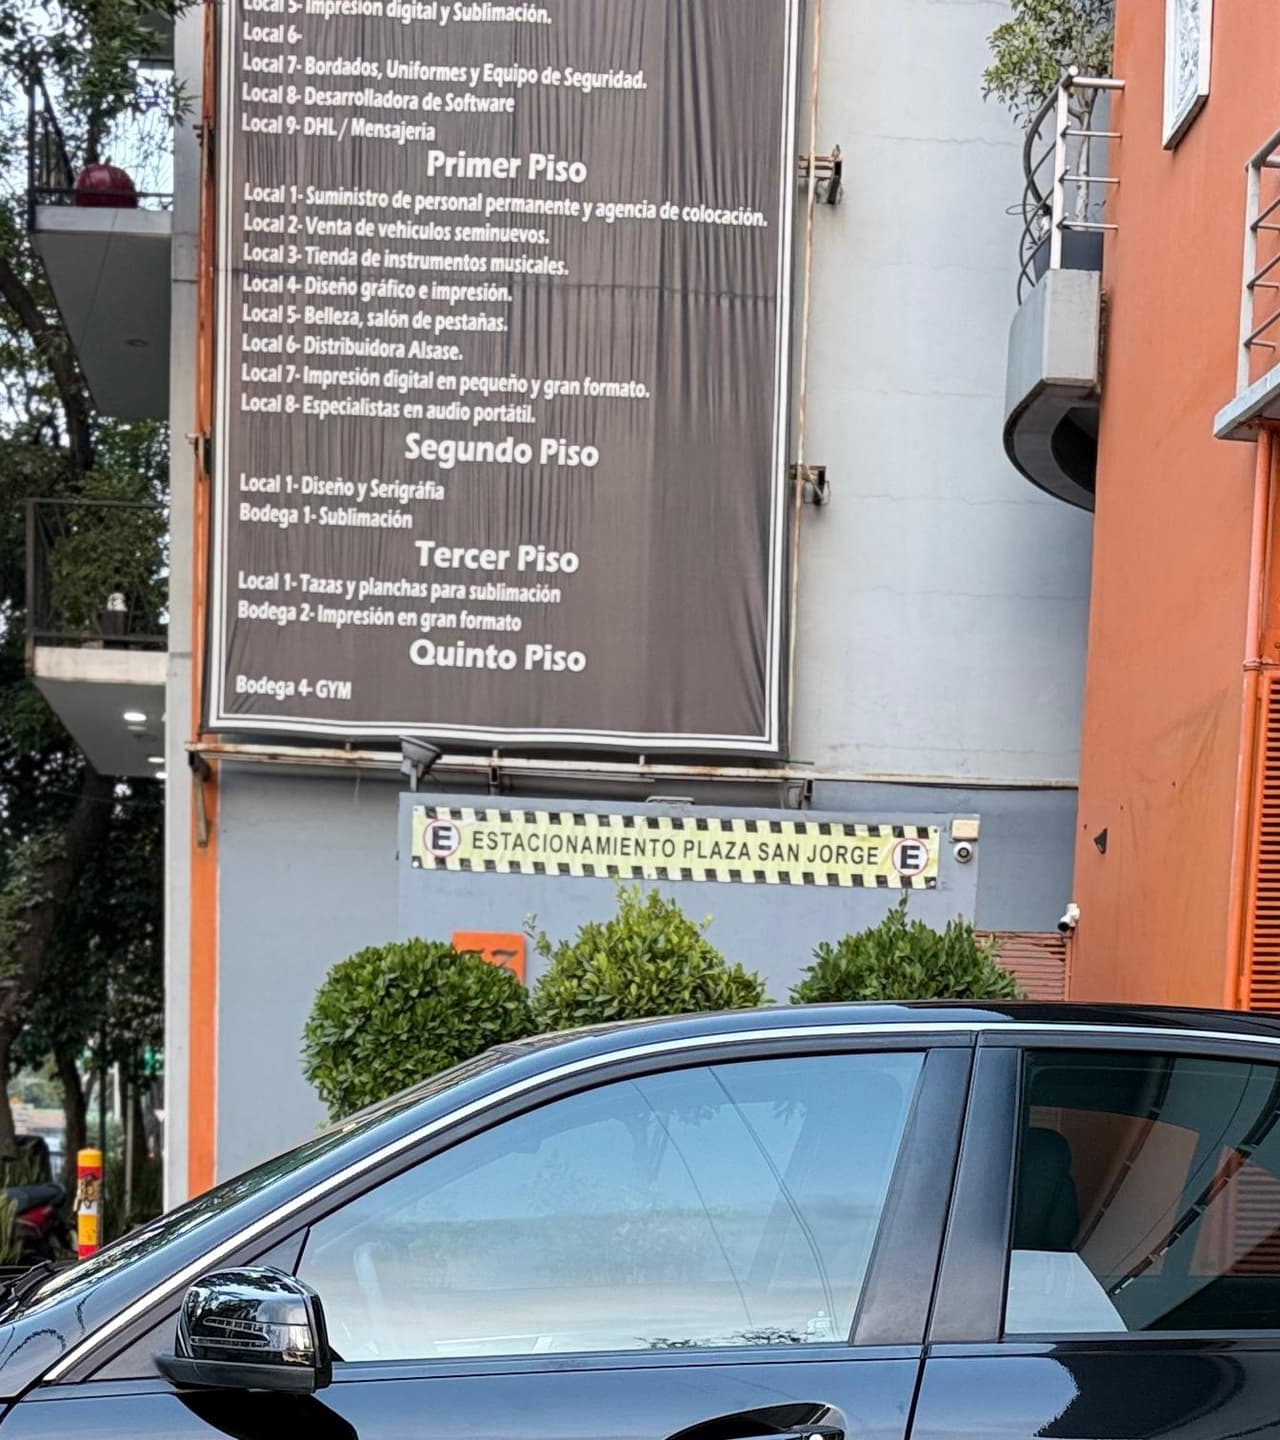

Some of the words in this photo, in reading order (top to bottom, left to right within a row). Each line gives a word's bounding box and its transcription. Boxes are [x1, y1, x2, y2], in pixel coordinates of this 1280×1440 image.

[242, 52, 283, 74] Local
[305, 56, 383, 80] Bordados,
[386, 59, 467, 82] Uniformes
[470, 68, 480, 87] y
[483, 63, 538, 88] Equipo
[541, 66, 561, 86] de
[564, 67, 648, 93] Seguridad.
[242, 82, 282, 104] Local
[304, 86, 418, 110] Desarrolladora
[421, 92, 442, 112] de
[445, 92, 515, 112] Software
[426, 150, 521, 179] Primer
[528, 153, 587, 183] Piso
[244, 182, 285, 203] Local
[305, 185, 389, 208] Suministro
[391, 190, 411, 210] de
[414, 192, 483, 215] personal
[484, 194, 580, 217] permanente
[582, 203, 593, 222] y
[595, 200, 656, 223] agencia
[659, 201, 679, 221] de
[682, 203, 768, 227] colocación.
[243, 242, 283, 264] Local
[304, 245, 358, 267] Tienda
[361, 249, 381, 268] de
[384, 249, 487, 273] instrumentos
[489, 254, 568, 276] musicales.
[242, 273, 283, 293] Local
[304, 276, 359, 297] Diseño
[361, 278, 416, 302] gráfico
[419, 287, 429, 298] e
[431, 281, 512, 306] impresión.
[242, 303, 282, 323] Local
[304, 305, 363, 329] Belleza,
[366, 308, 408, 328] salón
[411, 311, 432, 330] de
[434, 313, 508, 335] pestañas.
[242, 332, 282, 353] Local
[303, 335, 405, 359] Distribuidora
[241, 363, 282, 383] Local
[302, 365, 380, 390] Impresión
[383, 369, 434, 394] digital
[436, 374, 457, 390] en
[459, 373, 528, 397] pequeño
[530, 379, 540, 399] y
[543, 379, 580, 400] gran
[583, 376, 650, 399] formato.
[240, 392, 282, 413] Local
[302, 396, 401, 420] Especialistas
[403, 402, 423, 419] en
[426, 401, 471, 421] audio
[473, 403, 536, 426] portátil.
[404, 431, 533, 470] Segundo
[540, 437, 600, 467] Piso
[239, 472, 280, 493] Local
[301, 475, 355, 497] Diseño
[357, 483, 368, 502] y
[239, 502, 298, 528] Bodega
[318, 505, 413, 529] Sublimación
[415, 540, 511, 571] Tercer
[517, 544, 580, 573] Piso
[238, 571, 279, 591] Local
[300, 573, 344, 595] Tazas
[345, 583, 356, 600] y
[359, 577, 428, 600] planchas
[430, 585, 466, 603] para
[469, 582, 561, 604] sublimación
[238, 600, 297, 626] Bodega
[318, 603, 394, 630] Impresión
[397, 612, 418, 627] en
[420, 613, 456, 633] gran
[460, 609, 522, 632] formato
[409, 638, 517, 670] Quinto
[524, 644, 587, 673] Piso
[235, 674, 295, 700] Bodega
[316, 679, 352, 700] GYM
[472, 830, 676, 858] ESTACIONAMIENTO
[683, 839, 752, 860] PLAZA
[758, 842, 800, 862] SAN
[807, 844, 879, 865] JORGE
